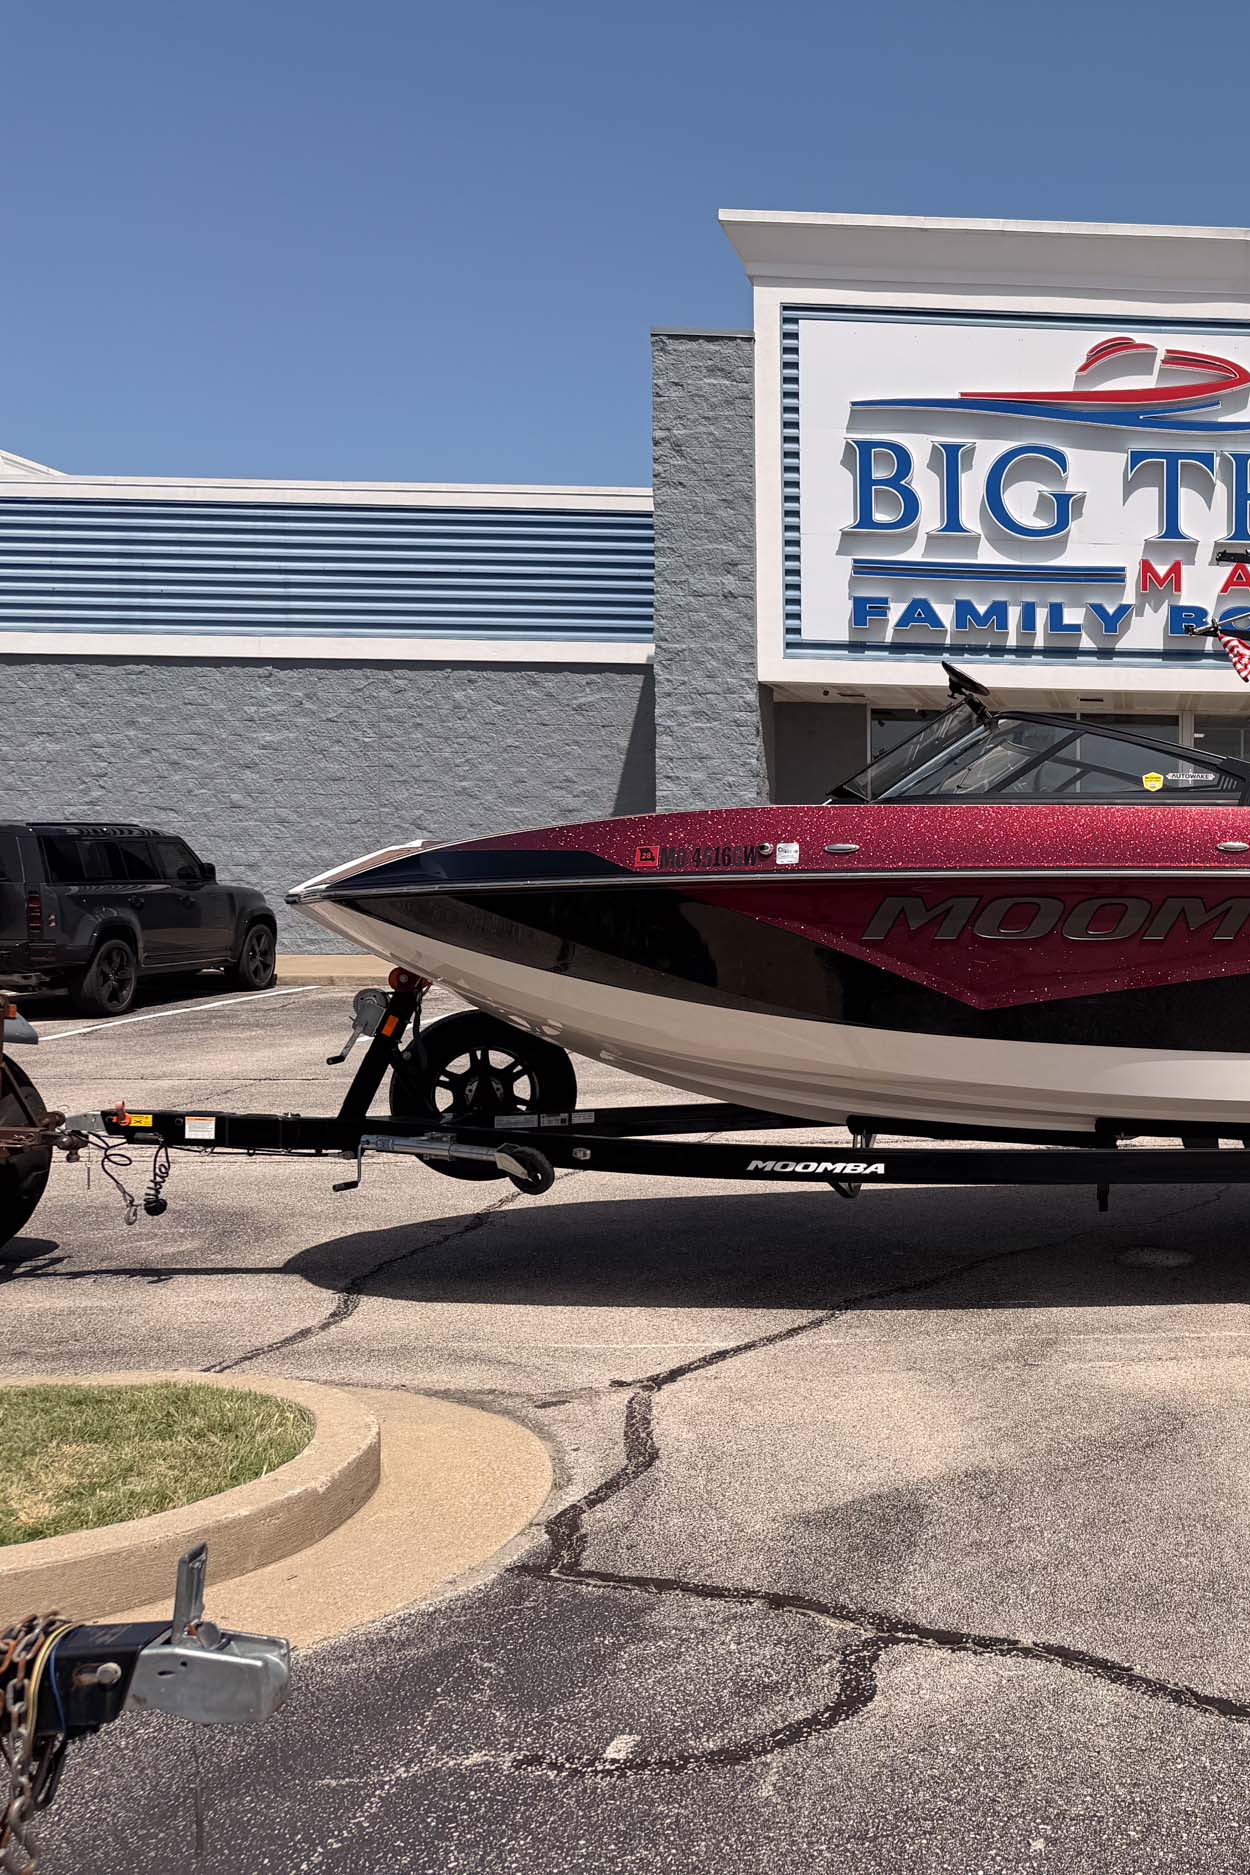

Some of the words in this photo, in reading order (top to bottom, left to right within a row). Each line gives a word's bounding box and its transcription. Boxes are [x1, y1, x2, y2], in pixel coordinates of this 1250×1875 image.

[841, 438, 1087, 541] BIG
[852, 595, 1134, 635] FAMILY
[1171, 772, 1211, 780] AUTOWAKE
[746, 1160, 886, 1175] MOOMBA
